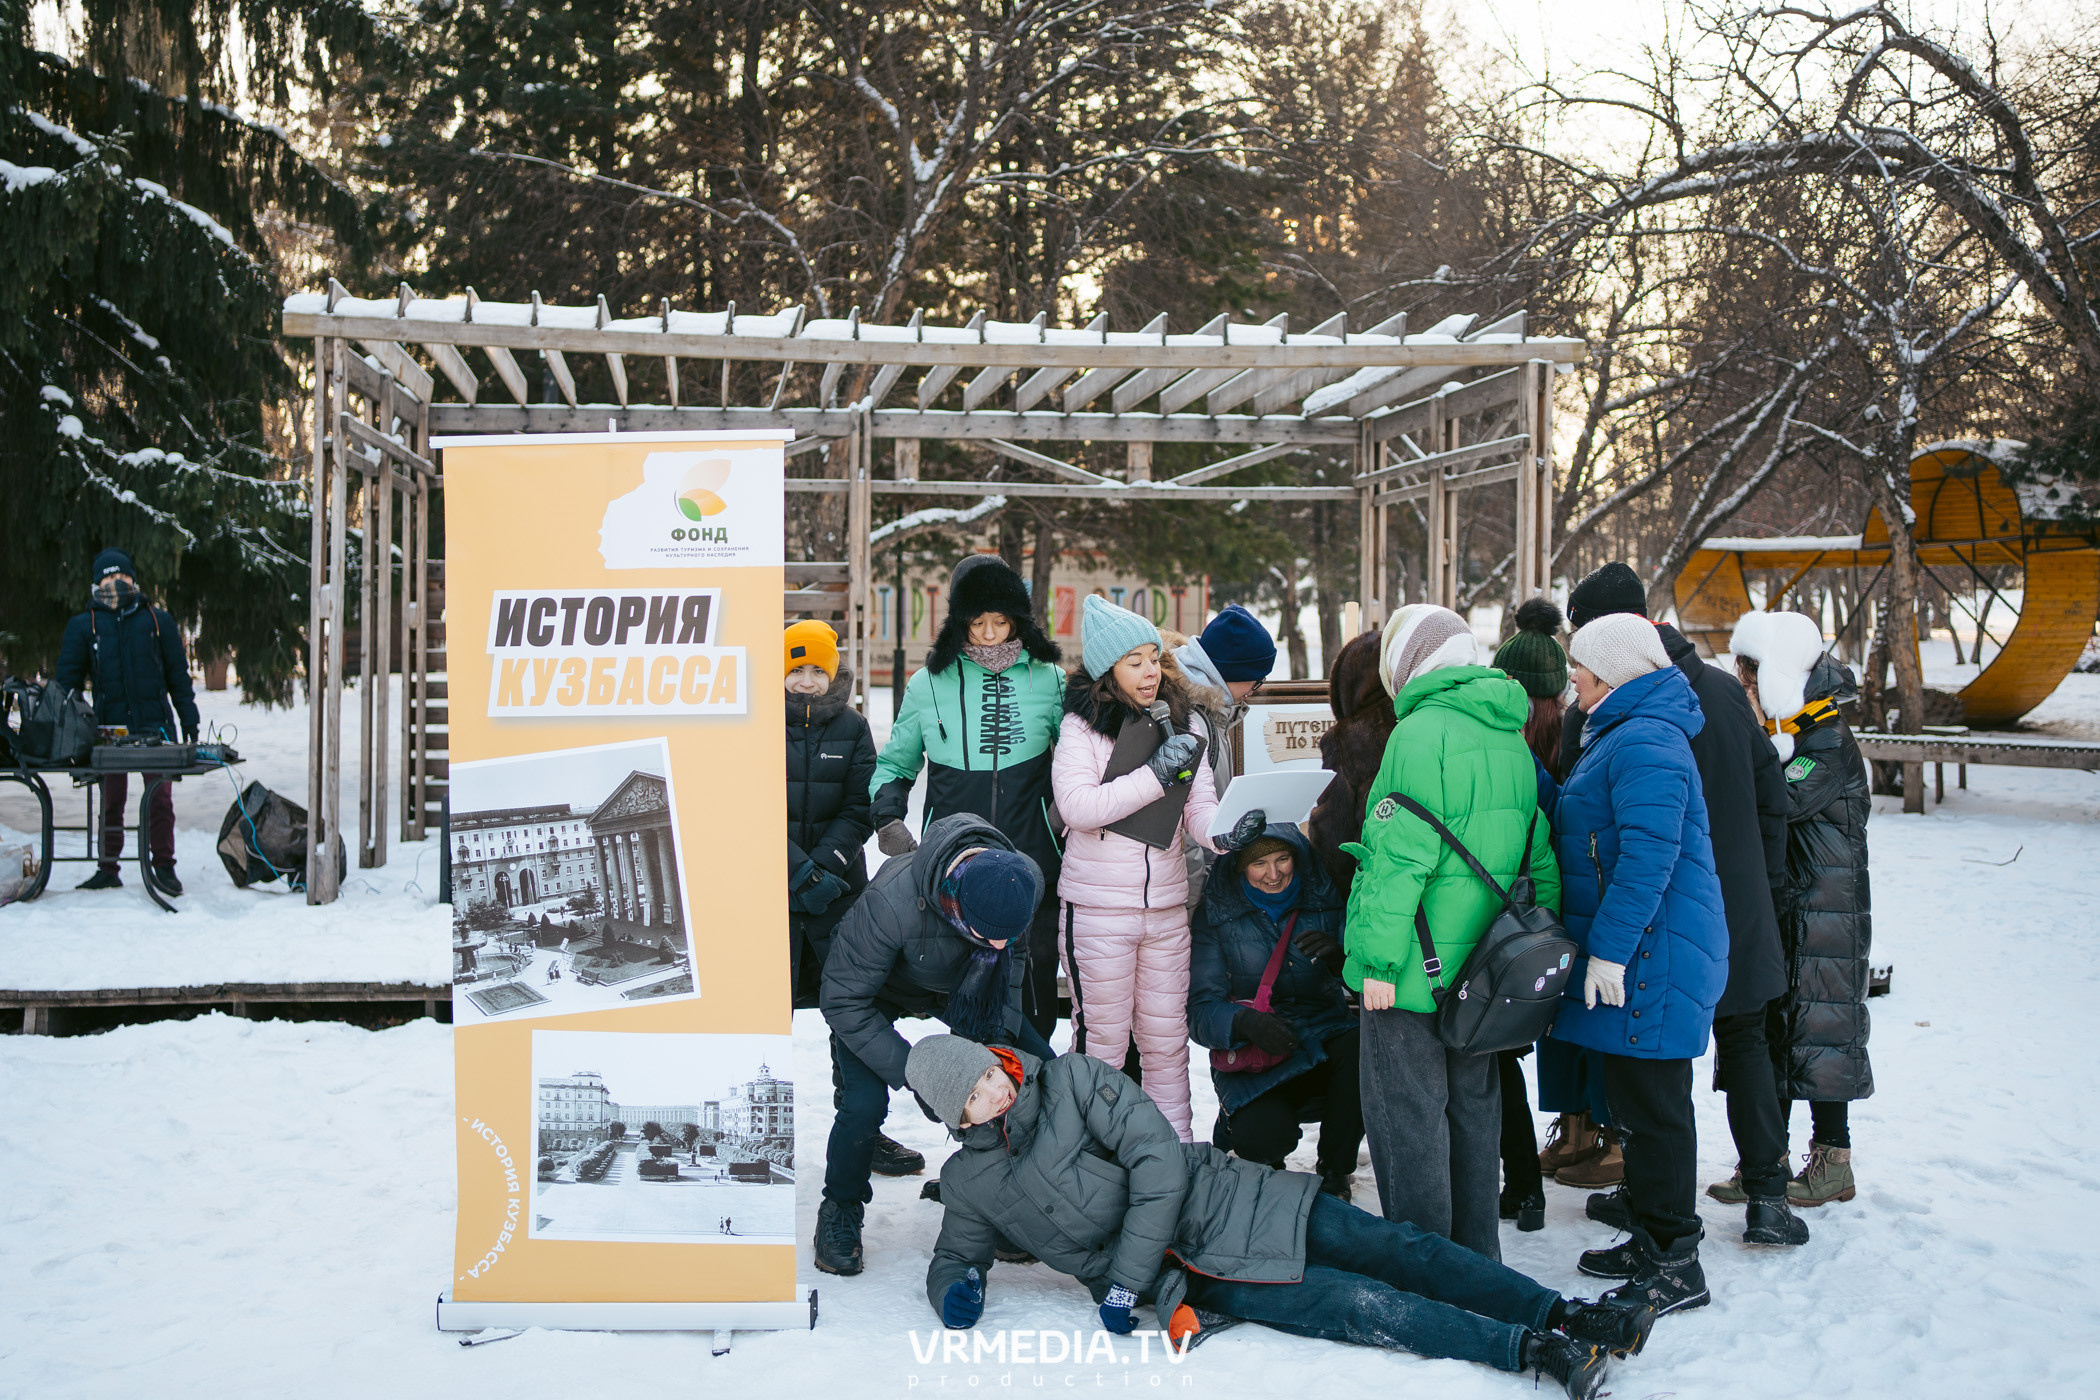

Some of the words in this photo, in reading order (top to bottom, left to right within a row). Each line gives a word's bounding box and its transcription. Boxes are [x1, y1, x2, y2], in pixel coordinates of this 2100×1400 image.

[670, 527, 729, 544] ФОНД
[494, 595, 712, 647] ИСТОРИЯ
[496, 655, 738, 707] КУЗБАССА
[1285, 736, 1307, 749] ПО
[470, 1118, 520, 1193] ИСТОРИЯ
[467, 1198, 520, 1279] КУЗБАССА
